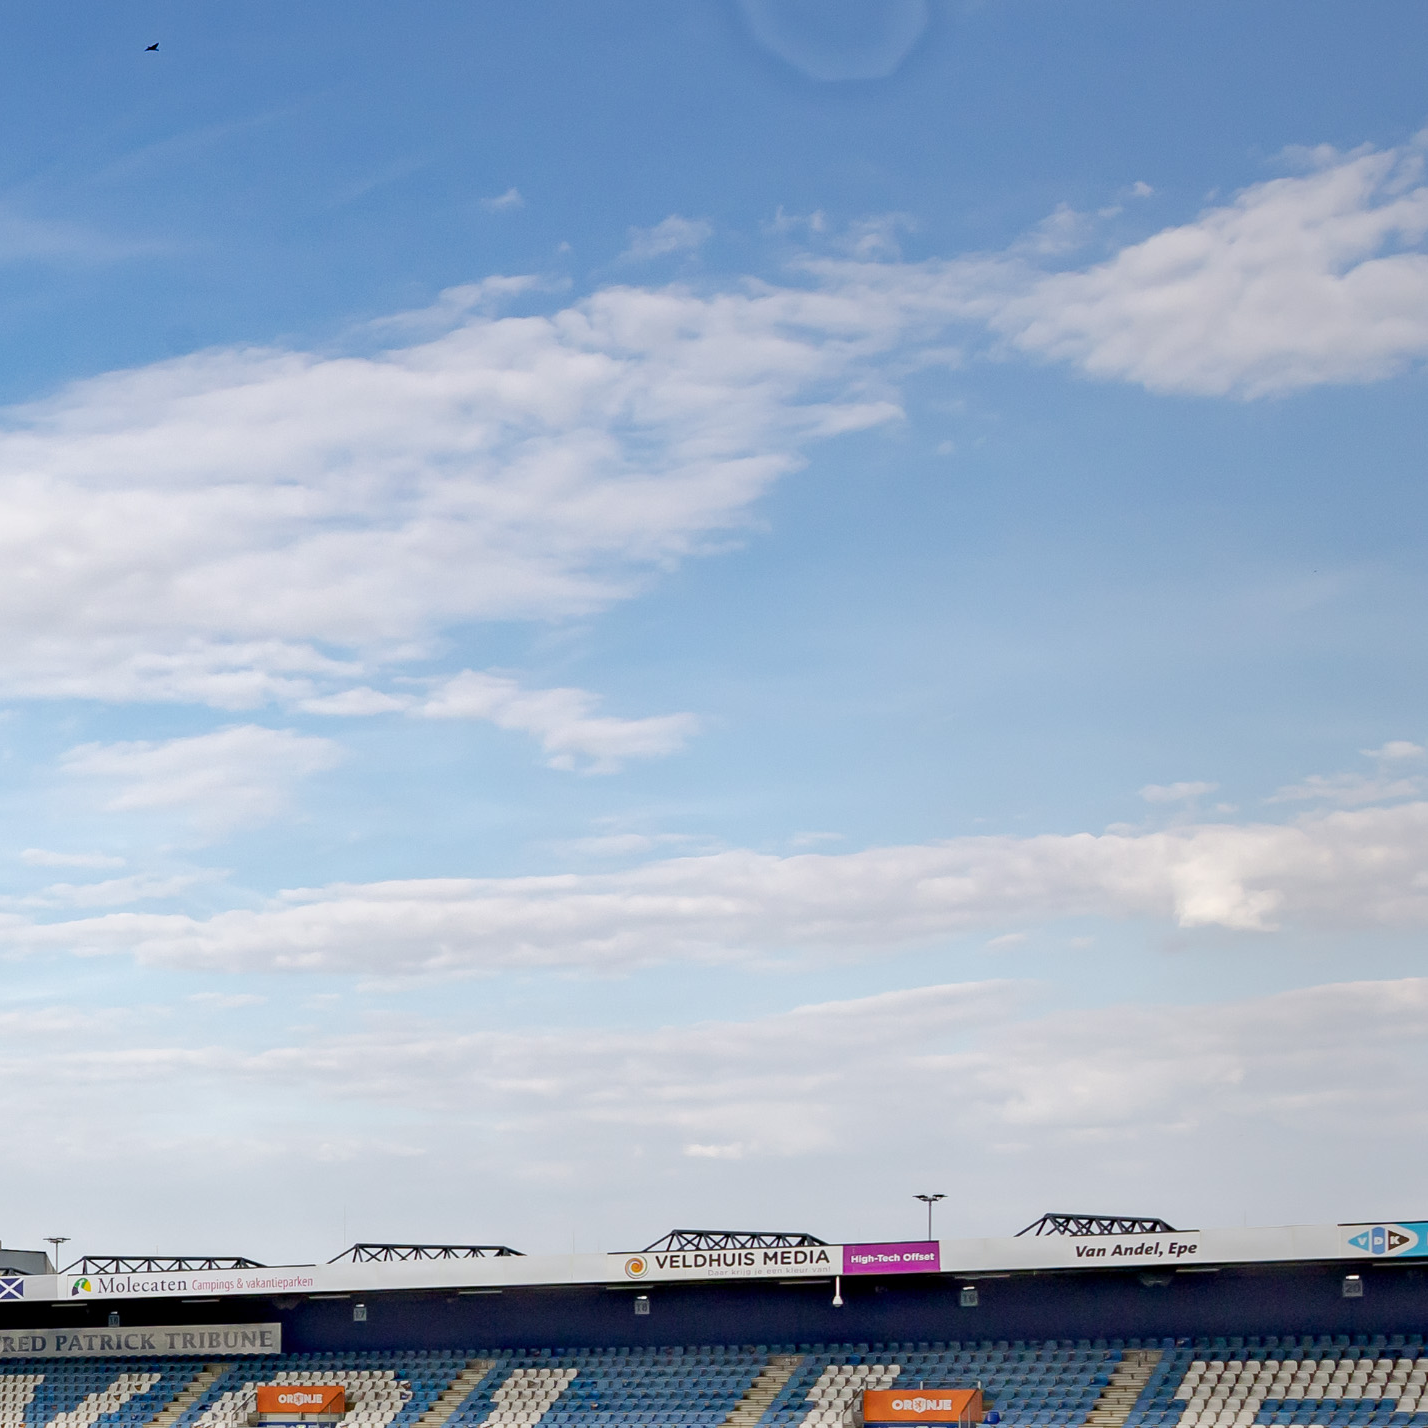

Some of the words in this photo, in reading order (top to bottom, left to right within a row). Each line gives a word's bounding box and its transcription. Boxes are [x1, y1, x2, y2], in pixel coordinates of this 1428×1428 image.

[1356, 1235, 1400, 1246] VDK
[1074, 1244, 1108, 1258] Van
[1111, 1242, 1163, 1258] Andel,
[1168, 1241, 1198, 1257] Epe
[655, 1252, 755, 1270] VELDHUIS
[762, 1249, 830, 1267] MEDIA
[851, 1252, 901, 1265] High-Tech
[902, 1251, 935, 1263] Offset
[707, 1269, 729, 1277] Daar
[731, 1268, 752, 1278] krijg
[754, 1268, 763, 1277] je
[785, 1266, 809, 1275] kleur
[811, 1266, 831, 1274] van!
[97, 1276, 188, 1294] Molecaten
[191, 1277, 235, 1292] Campings
[236, 1278, 244, 1289] &
[245, 1275, 314, 1291] vakantieparken
[1345, 1283, 1361, 1293] 20
[55, 1332, 156, 1351] PATRICK
[164, 1329, 273, 1349] TRIBUNE
